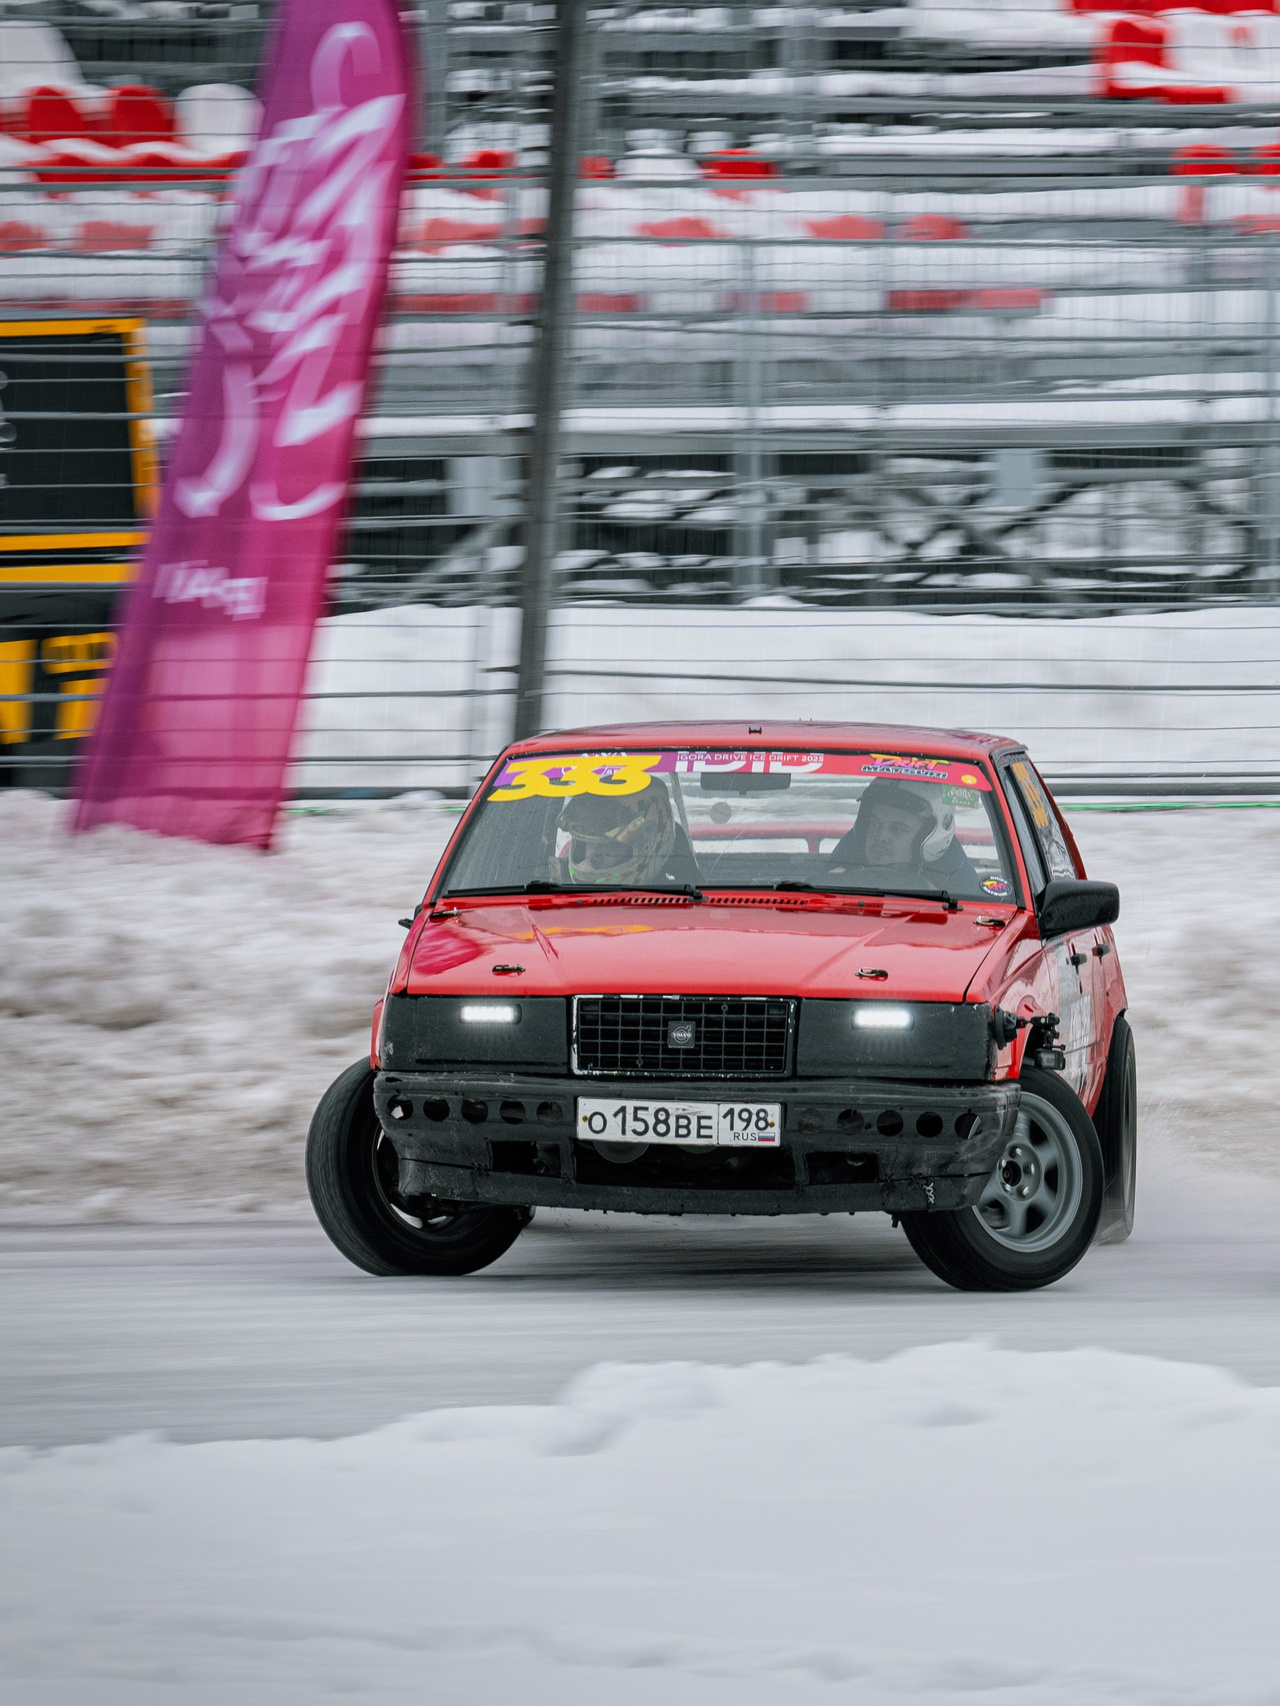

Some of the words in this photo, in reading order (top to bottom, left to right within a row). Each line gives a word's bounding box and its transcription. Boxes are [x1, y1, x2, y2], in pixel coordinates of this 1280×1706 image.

[677, 753, 712, 761] IGORA
[769, 754, 799, 762] DRIFT
[487, 755, 662, 802] 333
[861, 764, 948, 779] MATSURI
[722, 1107, 769, 1131] 198
[733, 1132, 757, 1141] RUS
